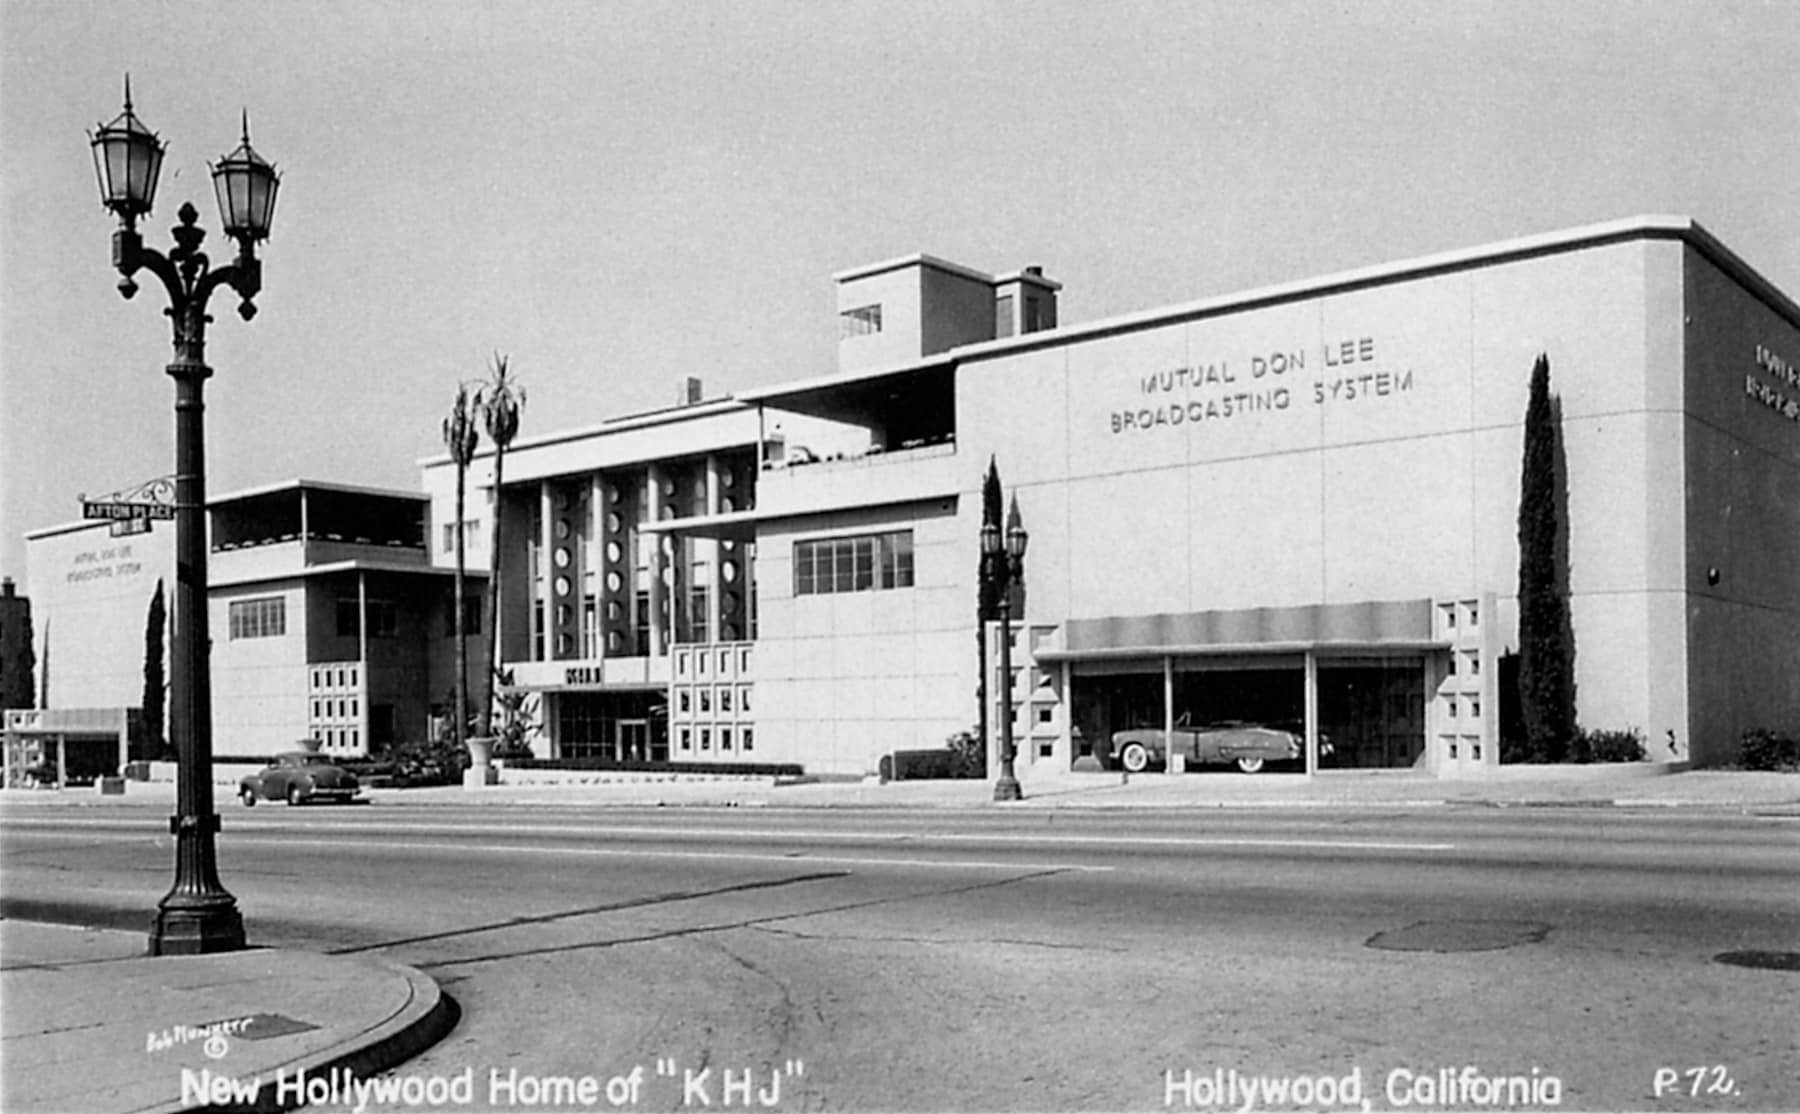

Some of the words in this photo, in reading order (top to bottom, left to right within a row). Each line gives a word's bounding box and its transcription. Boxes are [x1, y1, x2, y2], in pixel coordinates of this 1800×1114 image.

[1141, 362, 1236, 394] MUTUAL
[1252, 350, 1305, 378] DON
[1325, 338, 1374, 367] LEE
[1111, 388, 1290, 433] BROADCASTING
[1313, 369, 1414, 404] SYSTEM
